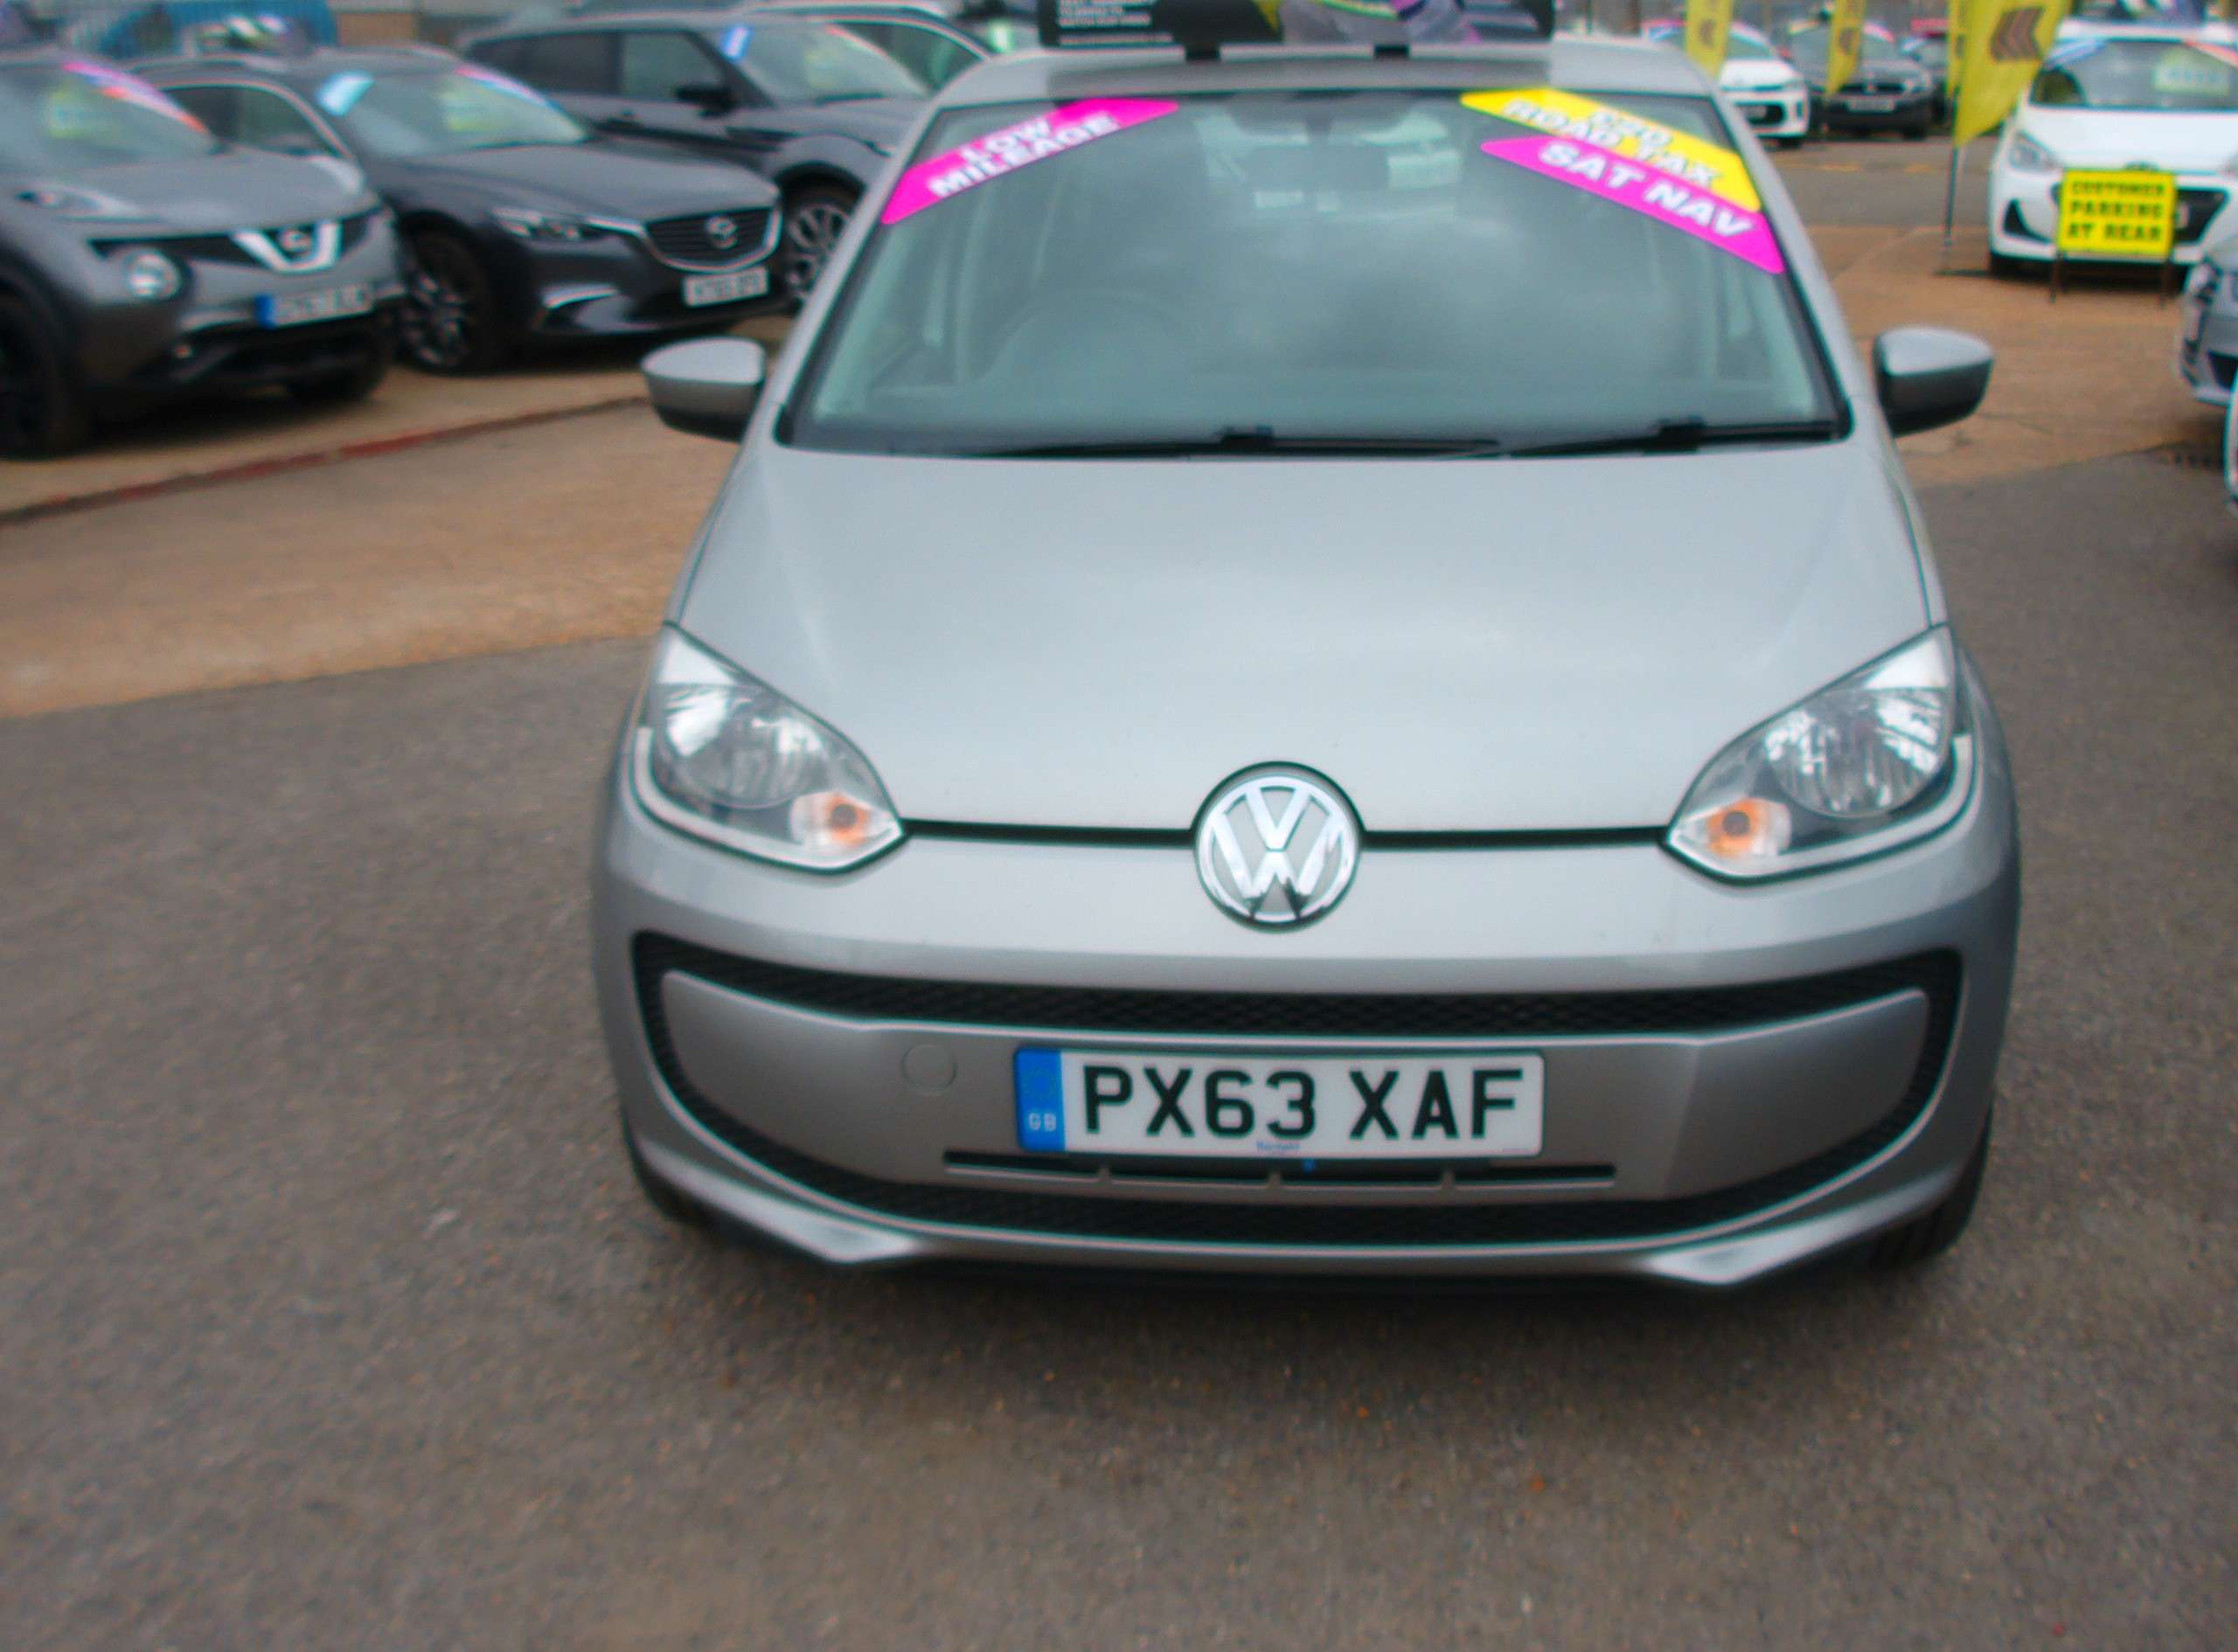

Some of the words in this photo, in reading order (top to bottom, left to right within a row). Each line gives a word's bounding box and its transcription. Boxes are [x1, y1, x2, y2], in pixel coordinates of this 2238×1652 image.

[925, 110, 1122, 198] MILEAGE
[959, 116, 1051, 164] LOW
[1503, 99, 1623, 148] ROAD
[1636, 136, 1724, 187] TAX
[1537, 140, 1646, 189] SAT
[1642, 179, 1753, 237] NAV
[2069, 200, 2165, 218] PARKING
[2072, 181, 2165, 197] CUSTOMER
[2067, 221, 2095, 239] AT
[2104, 223, 2163, 241] REAR
[1027, 1113, 1057, 1132] GB
[1082, 1065, 1317, 1140] PX63
[1347, 1067, 1524, 1141] XAF
